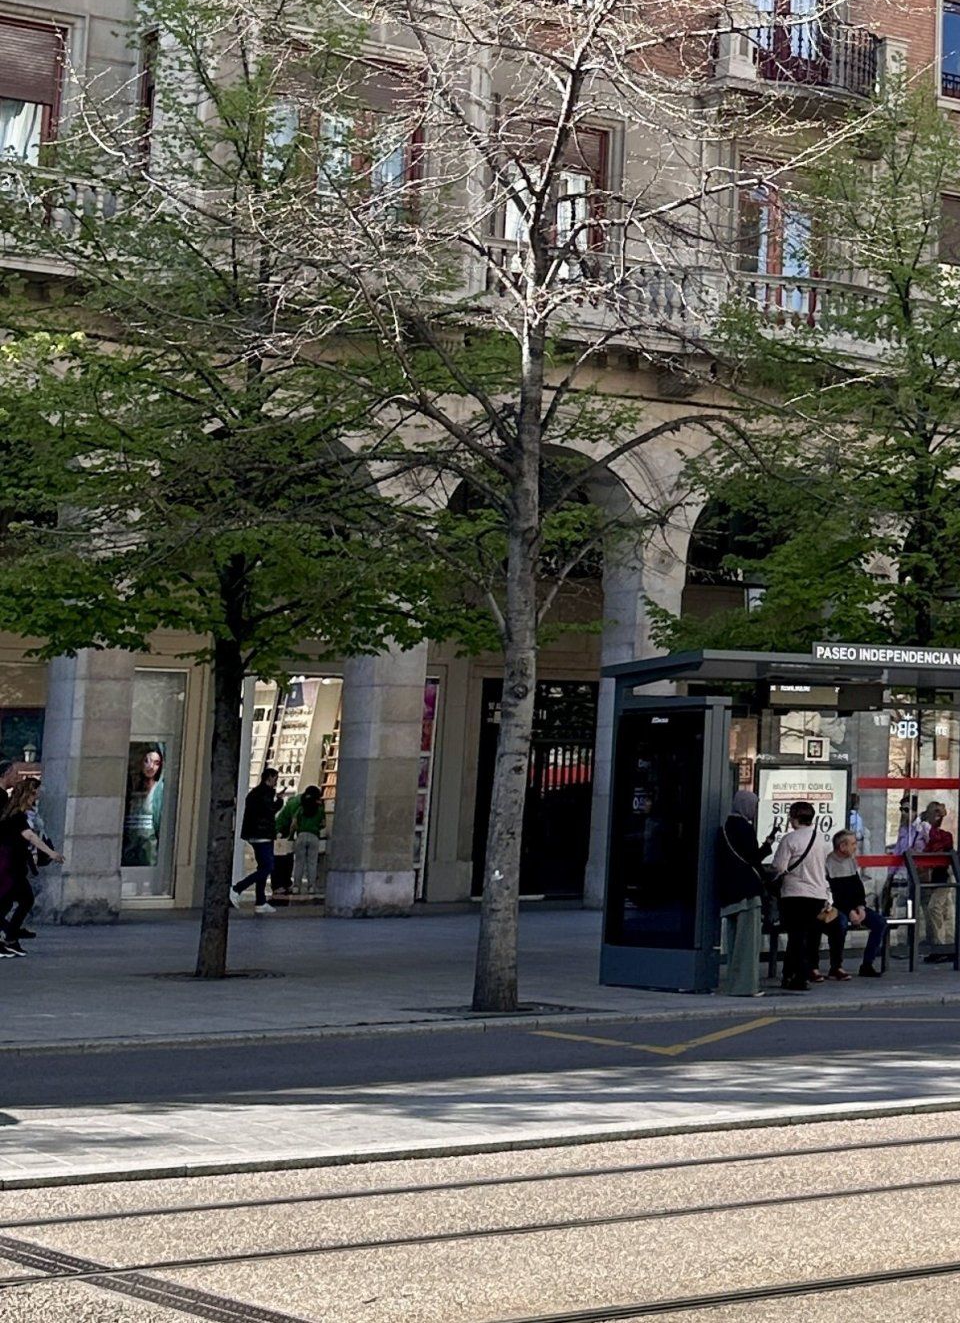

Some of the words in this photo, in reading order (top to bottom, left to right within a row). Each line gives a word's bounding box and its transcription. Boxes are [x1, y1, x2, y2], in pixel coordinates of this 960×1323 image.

[816, 646, 857, 661] PASEO
[859, 648, 951, 664] INDEPENDENCIA
[818, 802, 833, 814] EL
